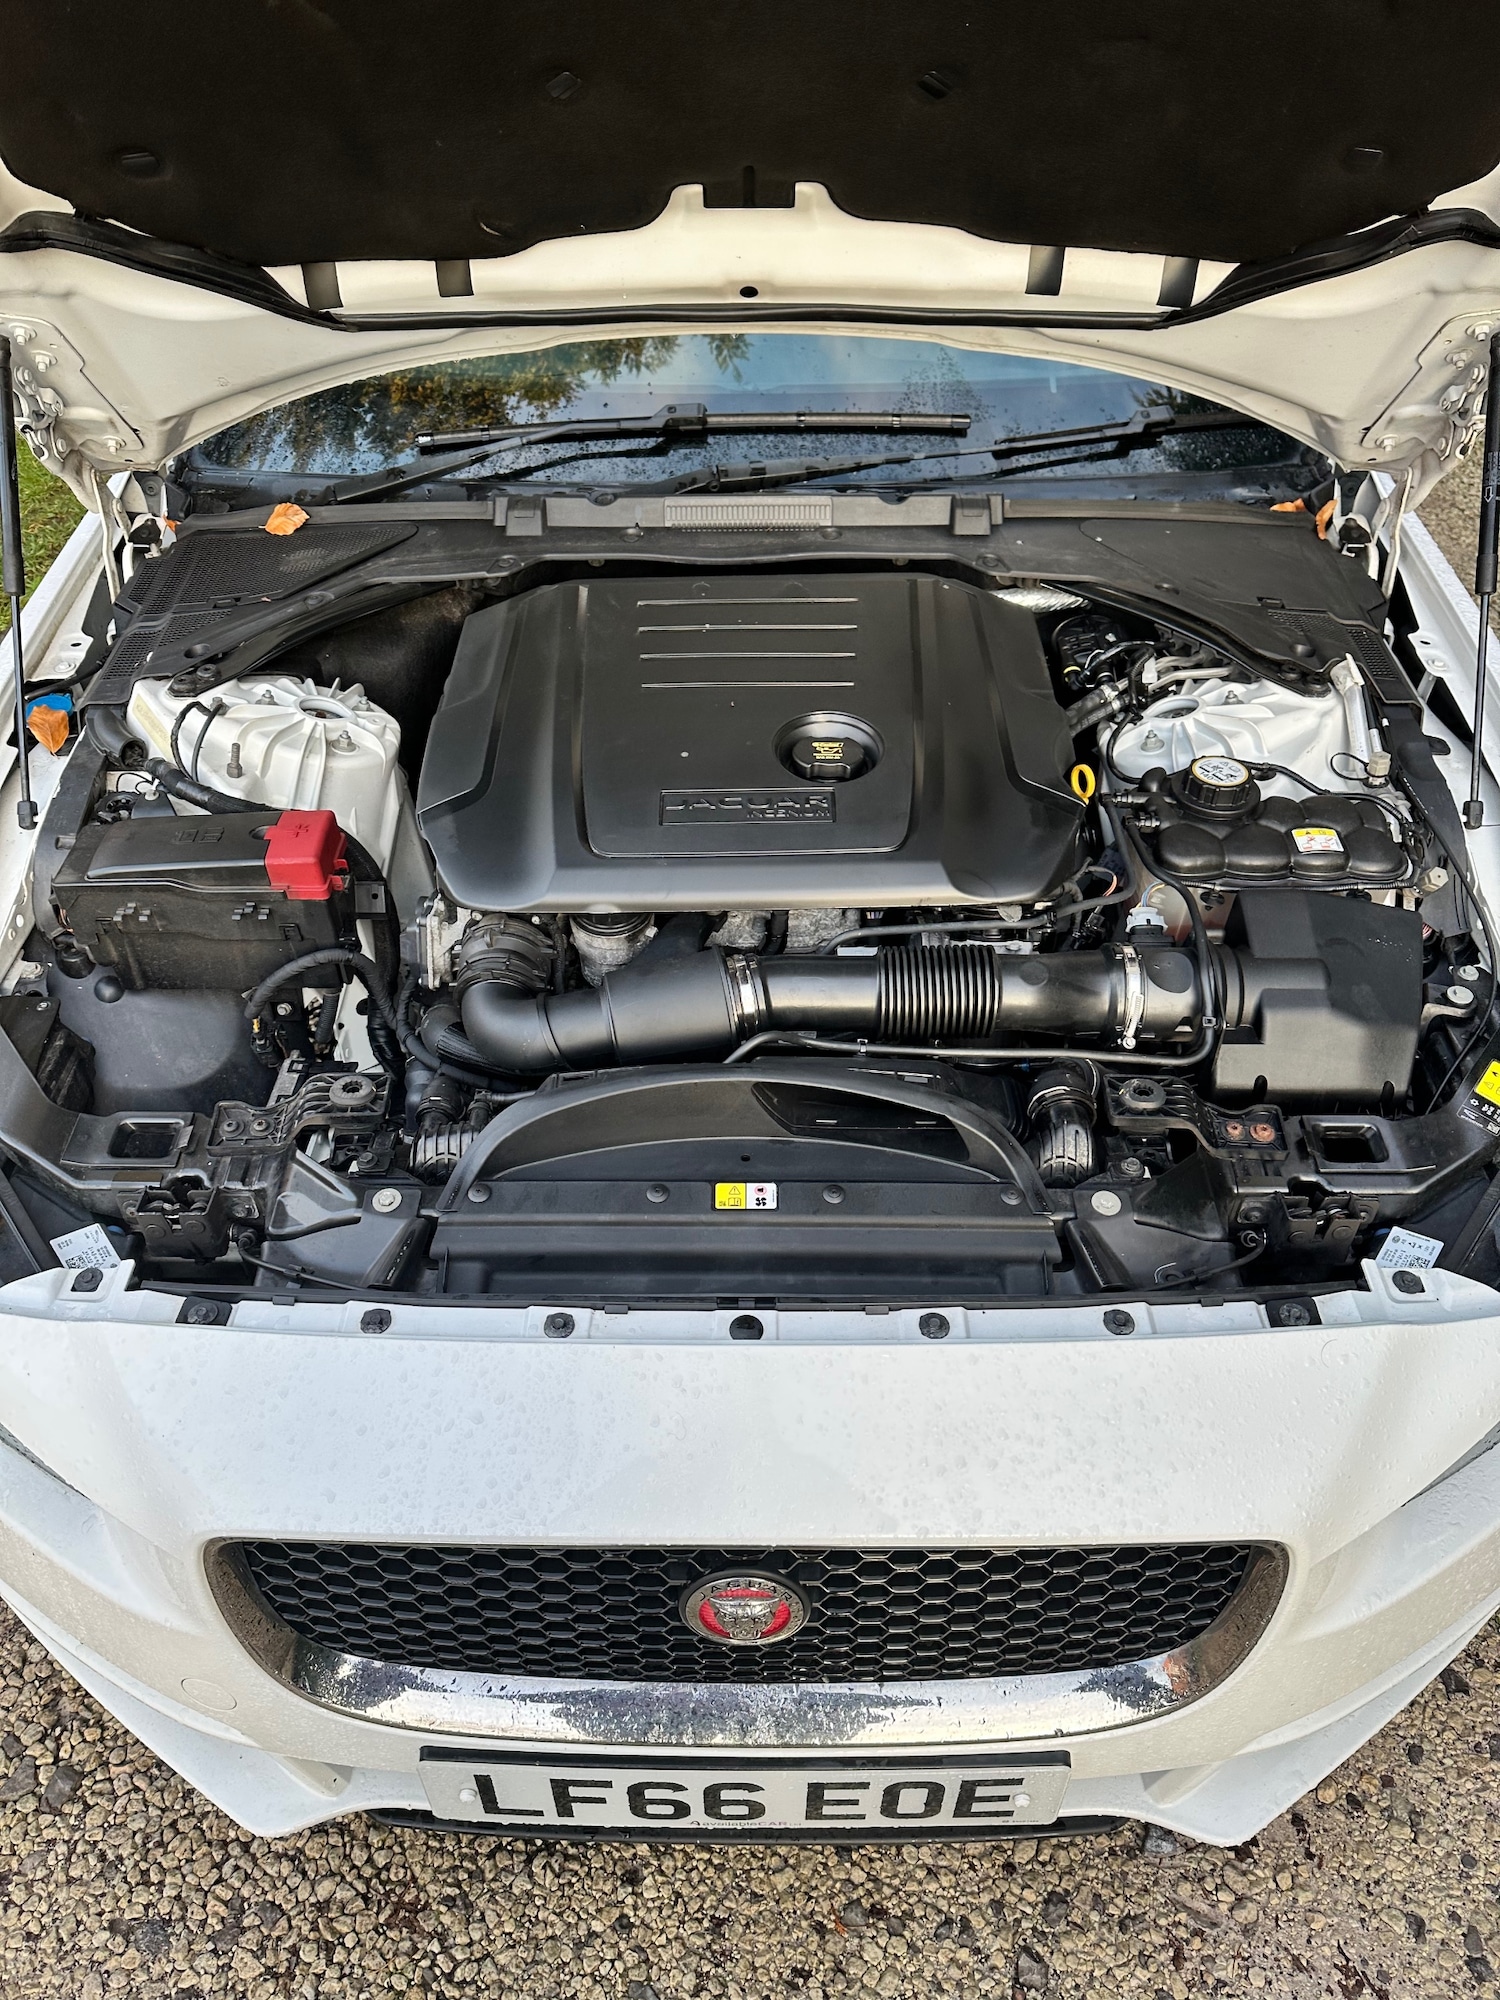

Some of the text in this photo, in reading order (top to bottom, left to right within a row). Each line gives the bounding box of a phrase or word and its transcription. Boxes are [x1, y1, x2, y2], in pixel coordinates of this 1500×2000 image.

[664, 796, 829, 811] JAGUAR
[699, 1580, 793, 1602] JAGUAR
[473, 1774, 1025, 1821] LF66 EOE
